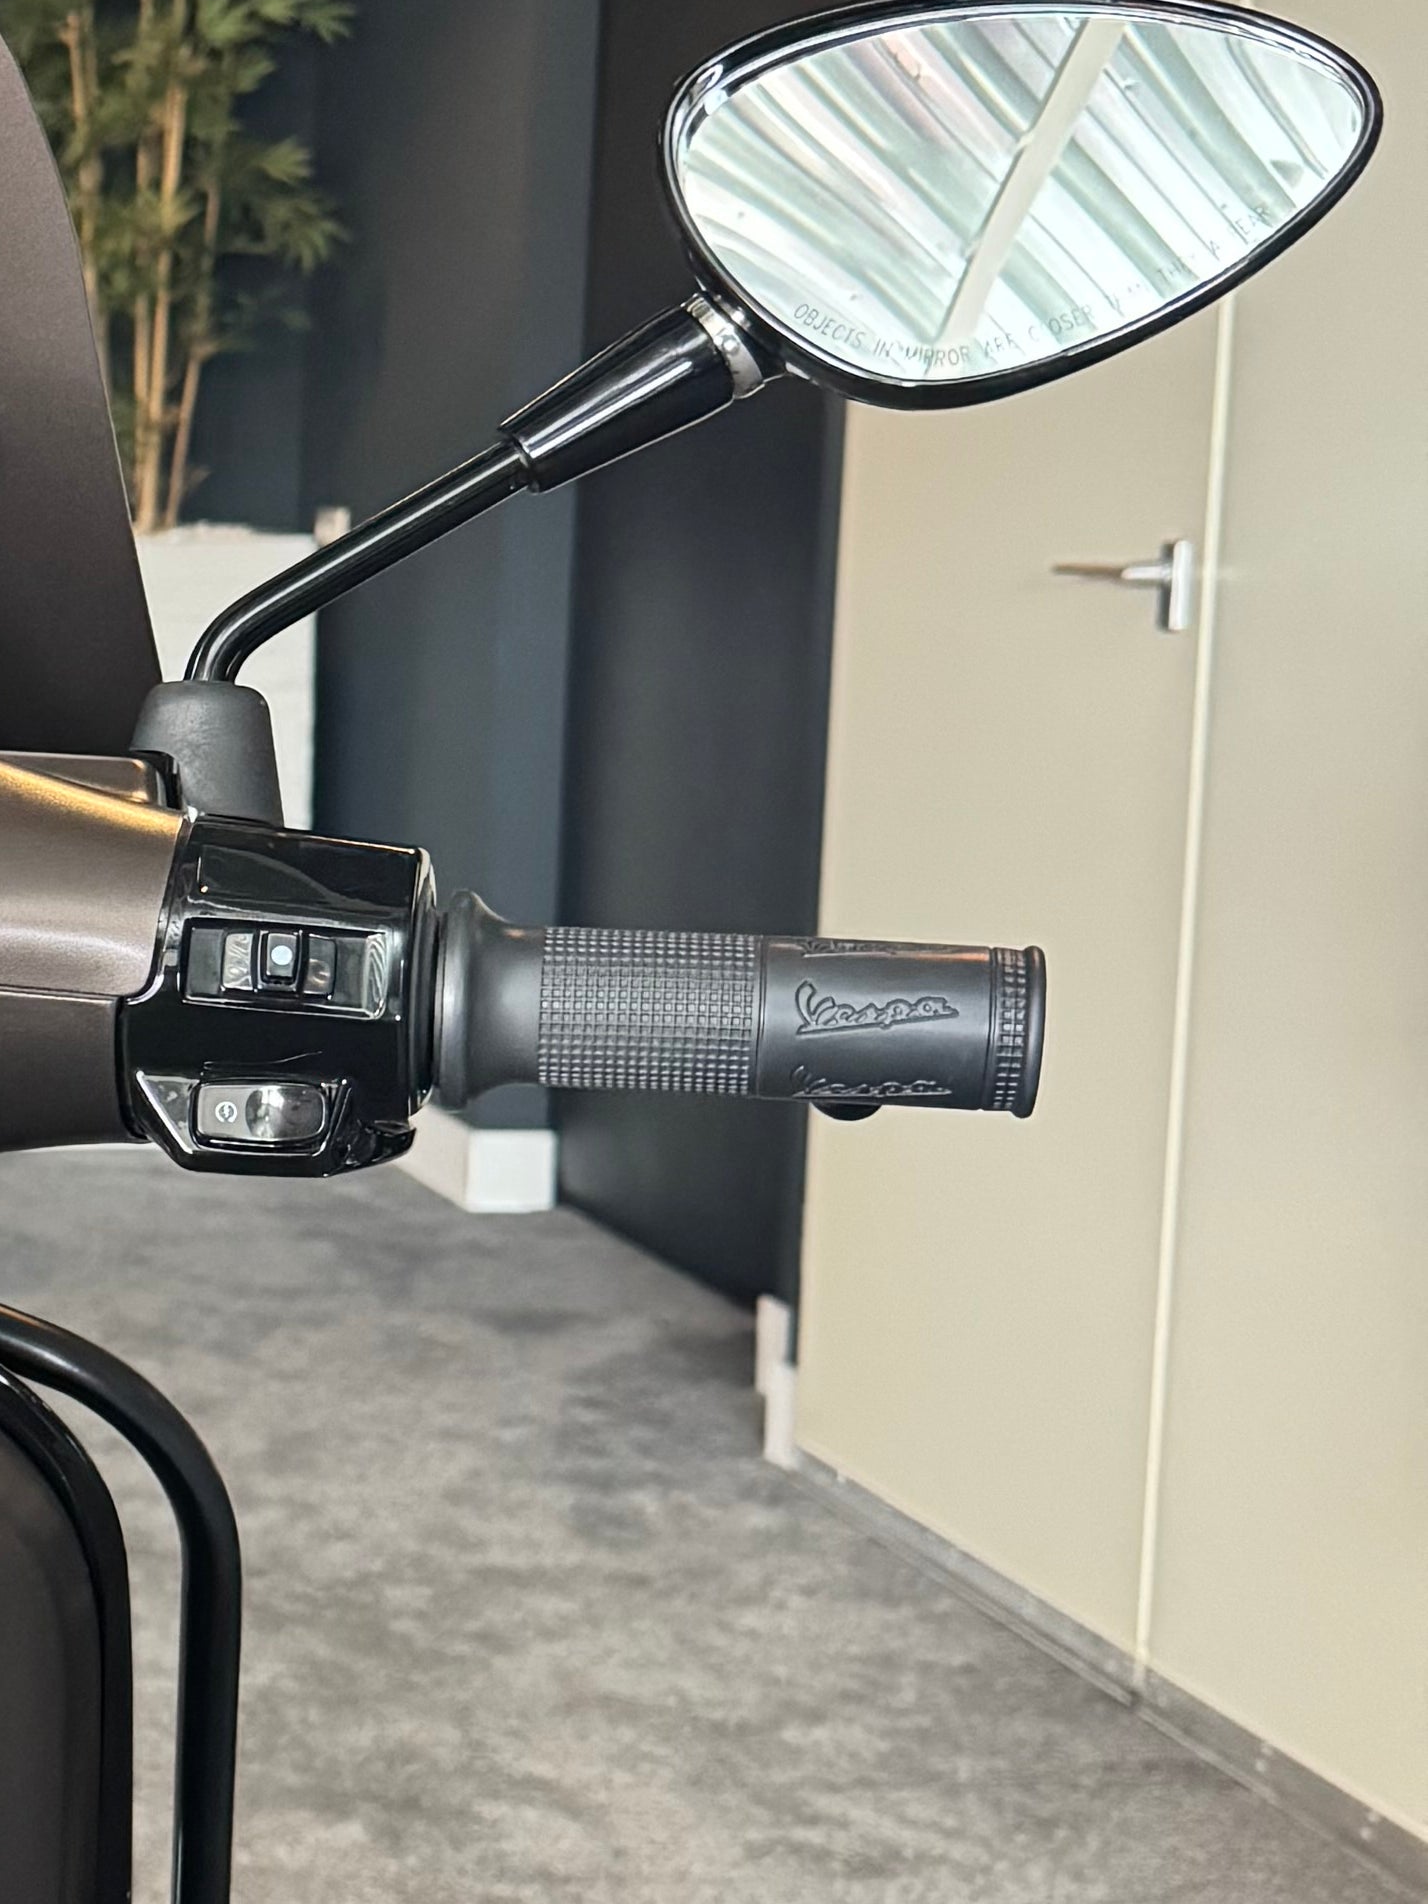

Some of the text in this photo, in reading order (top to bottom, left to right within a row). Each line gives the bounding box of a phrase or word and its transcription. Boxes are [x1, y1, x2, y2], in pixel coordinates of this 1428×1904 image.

[794, 303, 866, 348] OBJECTS
[873, 338, 892, 358] IN
[1028, 304, 1095, 342] COSER
[795, 979, 959, 1034] Vespa
